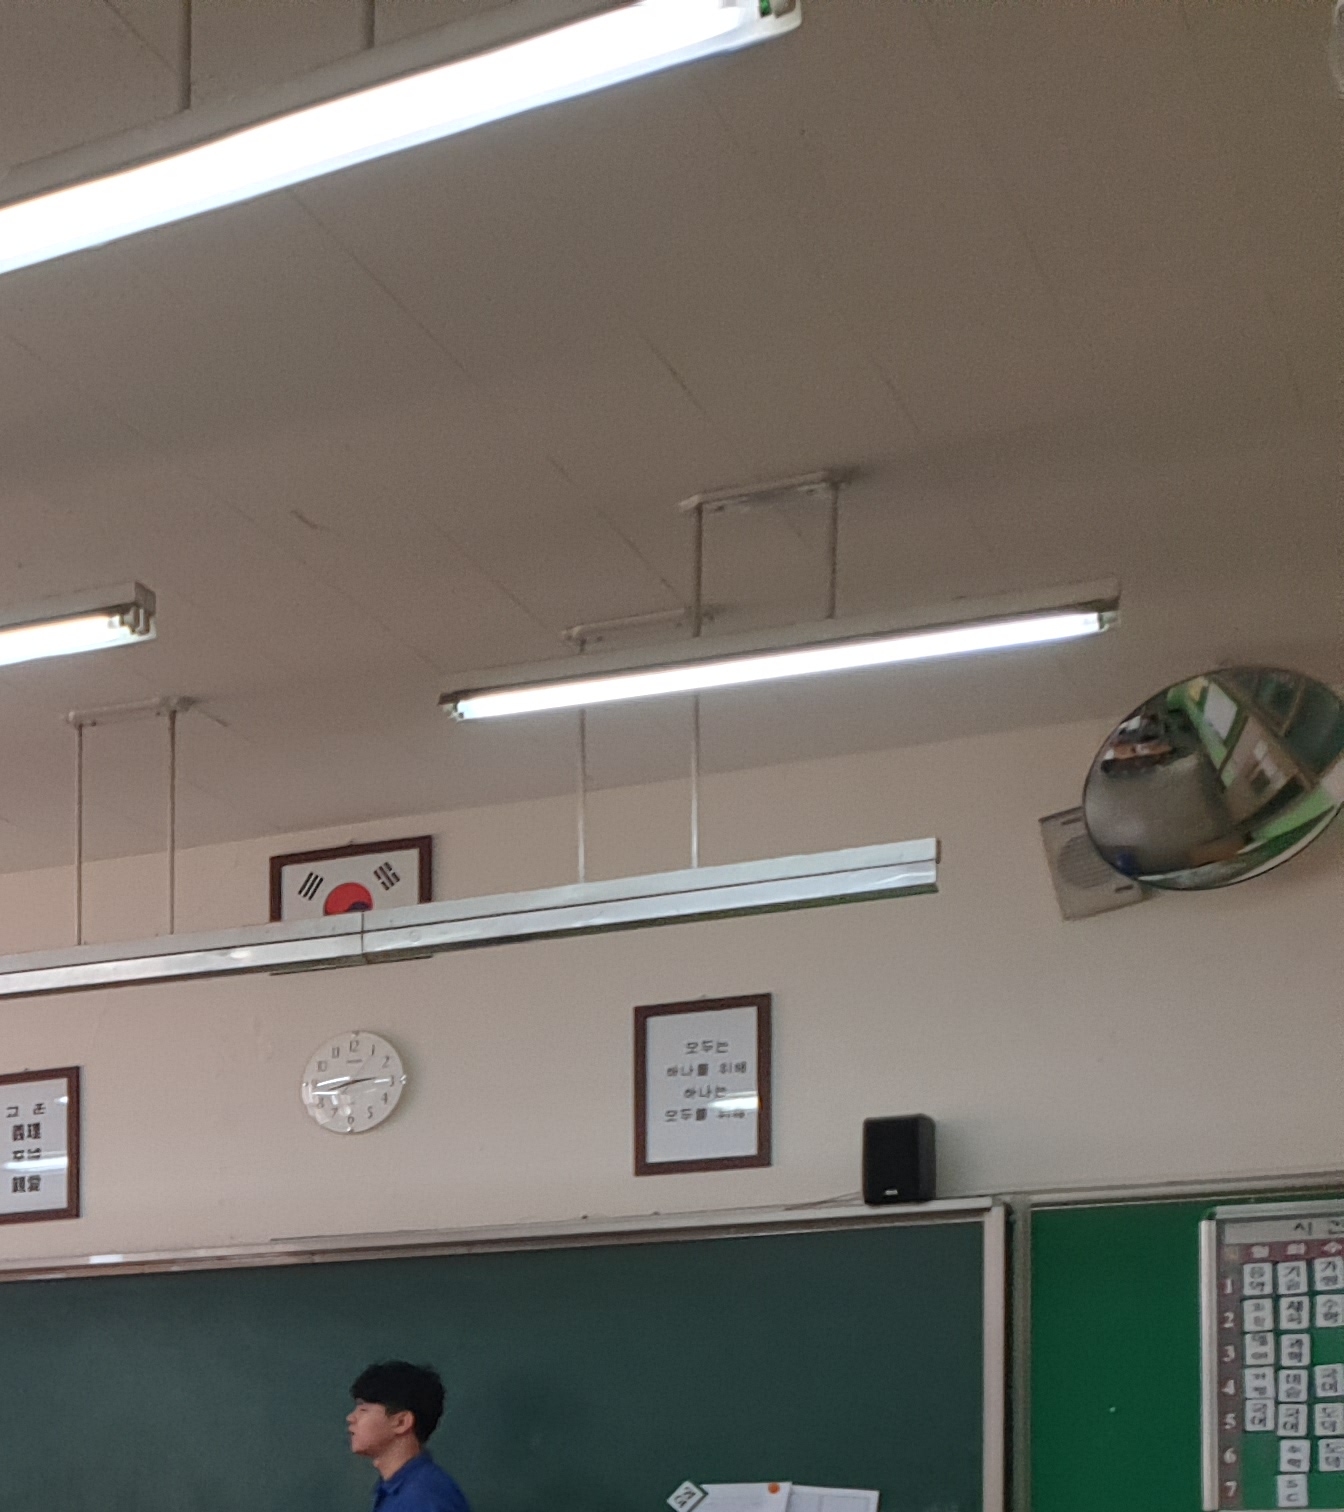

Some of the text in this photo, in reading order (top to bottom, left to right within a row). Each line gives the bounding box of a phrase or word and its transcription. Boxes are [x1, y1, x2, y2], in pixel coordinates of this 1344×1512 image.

[1223, 1311, 1234, 1328] 2
[1221, 1344, 1235, 1362] 3
[1221, 1379, 1236, 1396] 4
[1224, 1413, 1237, 1429] 5
[1223, 1447, 1237, 1464] 6
[1224, 1480, 1237, 1497] 7
